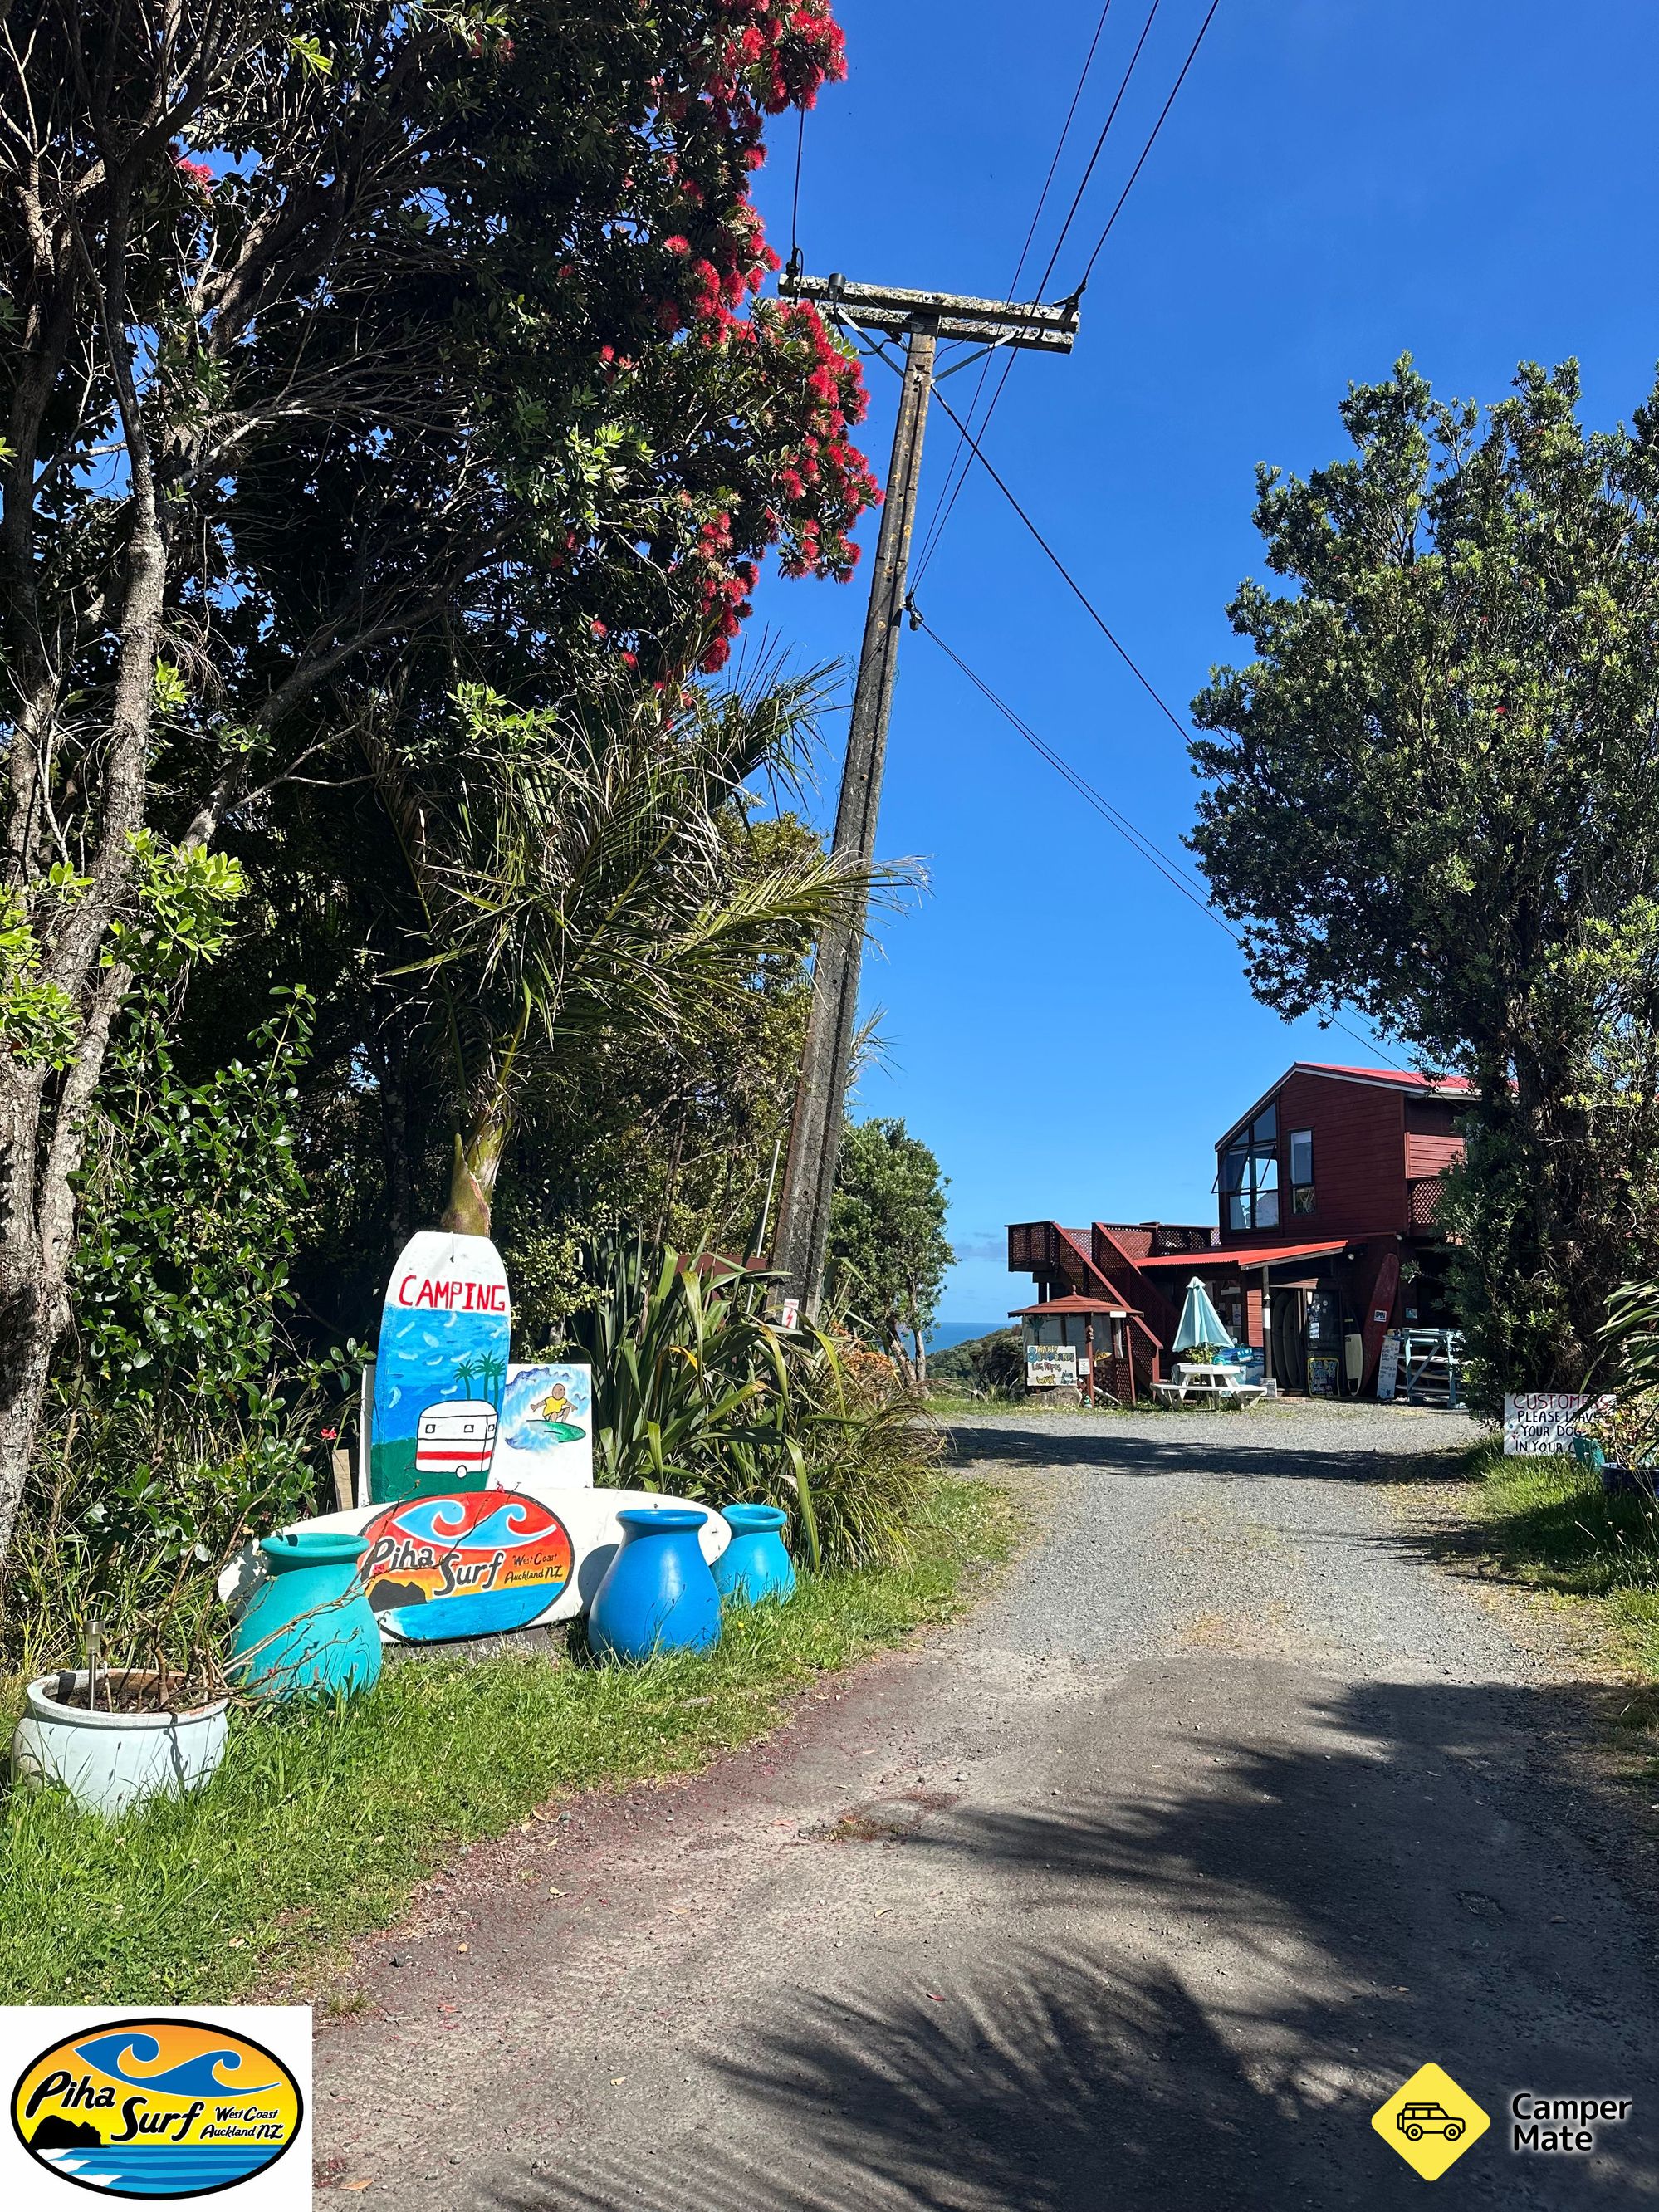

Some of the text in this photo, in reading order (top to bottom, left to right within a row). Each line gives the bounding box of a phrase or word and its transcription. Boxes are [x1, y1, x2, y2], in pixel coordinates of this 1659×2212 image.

[399, 1275, 506, 1312] CAMPING
[1518, 1411, 1560, 1422] PLEASE
[1521, 1425, 1550, 1436] YOUR
[1515, 1441, 1528, 1452] IN
[1532, 1441, 1563, 1453] YOUR
[359, 1539, 504, 1596] Piha Surf
[504, 1571, 544, 1583] Auckland
